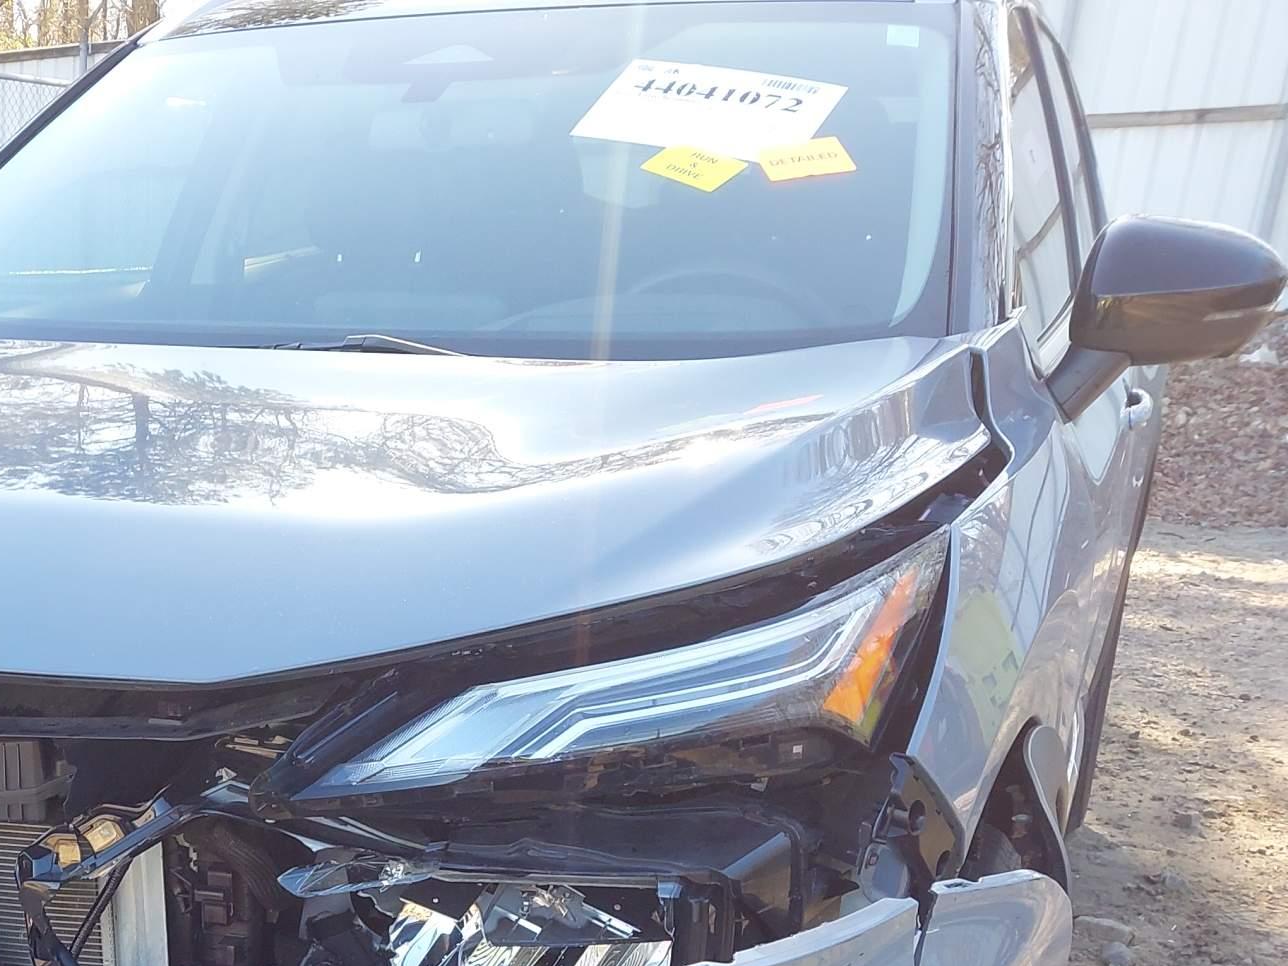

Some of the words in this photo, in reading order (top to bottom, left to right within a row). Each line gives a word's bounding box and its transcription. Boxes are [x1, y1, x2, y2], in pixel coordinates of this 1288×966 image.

[634, 78, 803, 112] 44041072
[691, 150, 718, 165] RUN
[769, 151, 838, 167] DETAILED
[665, 163, 703, 181] DRIVE
